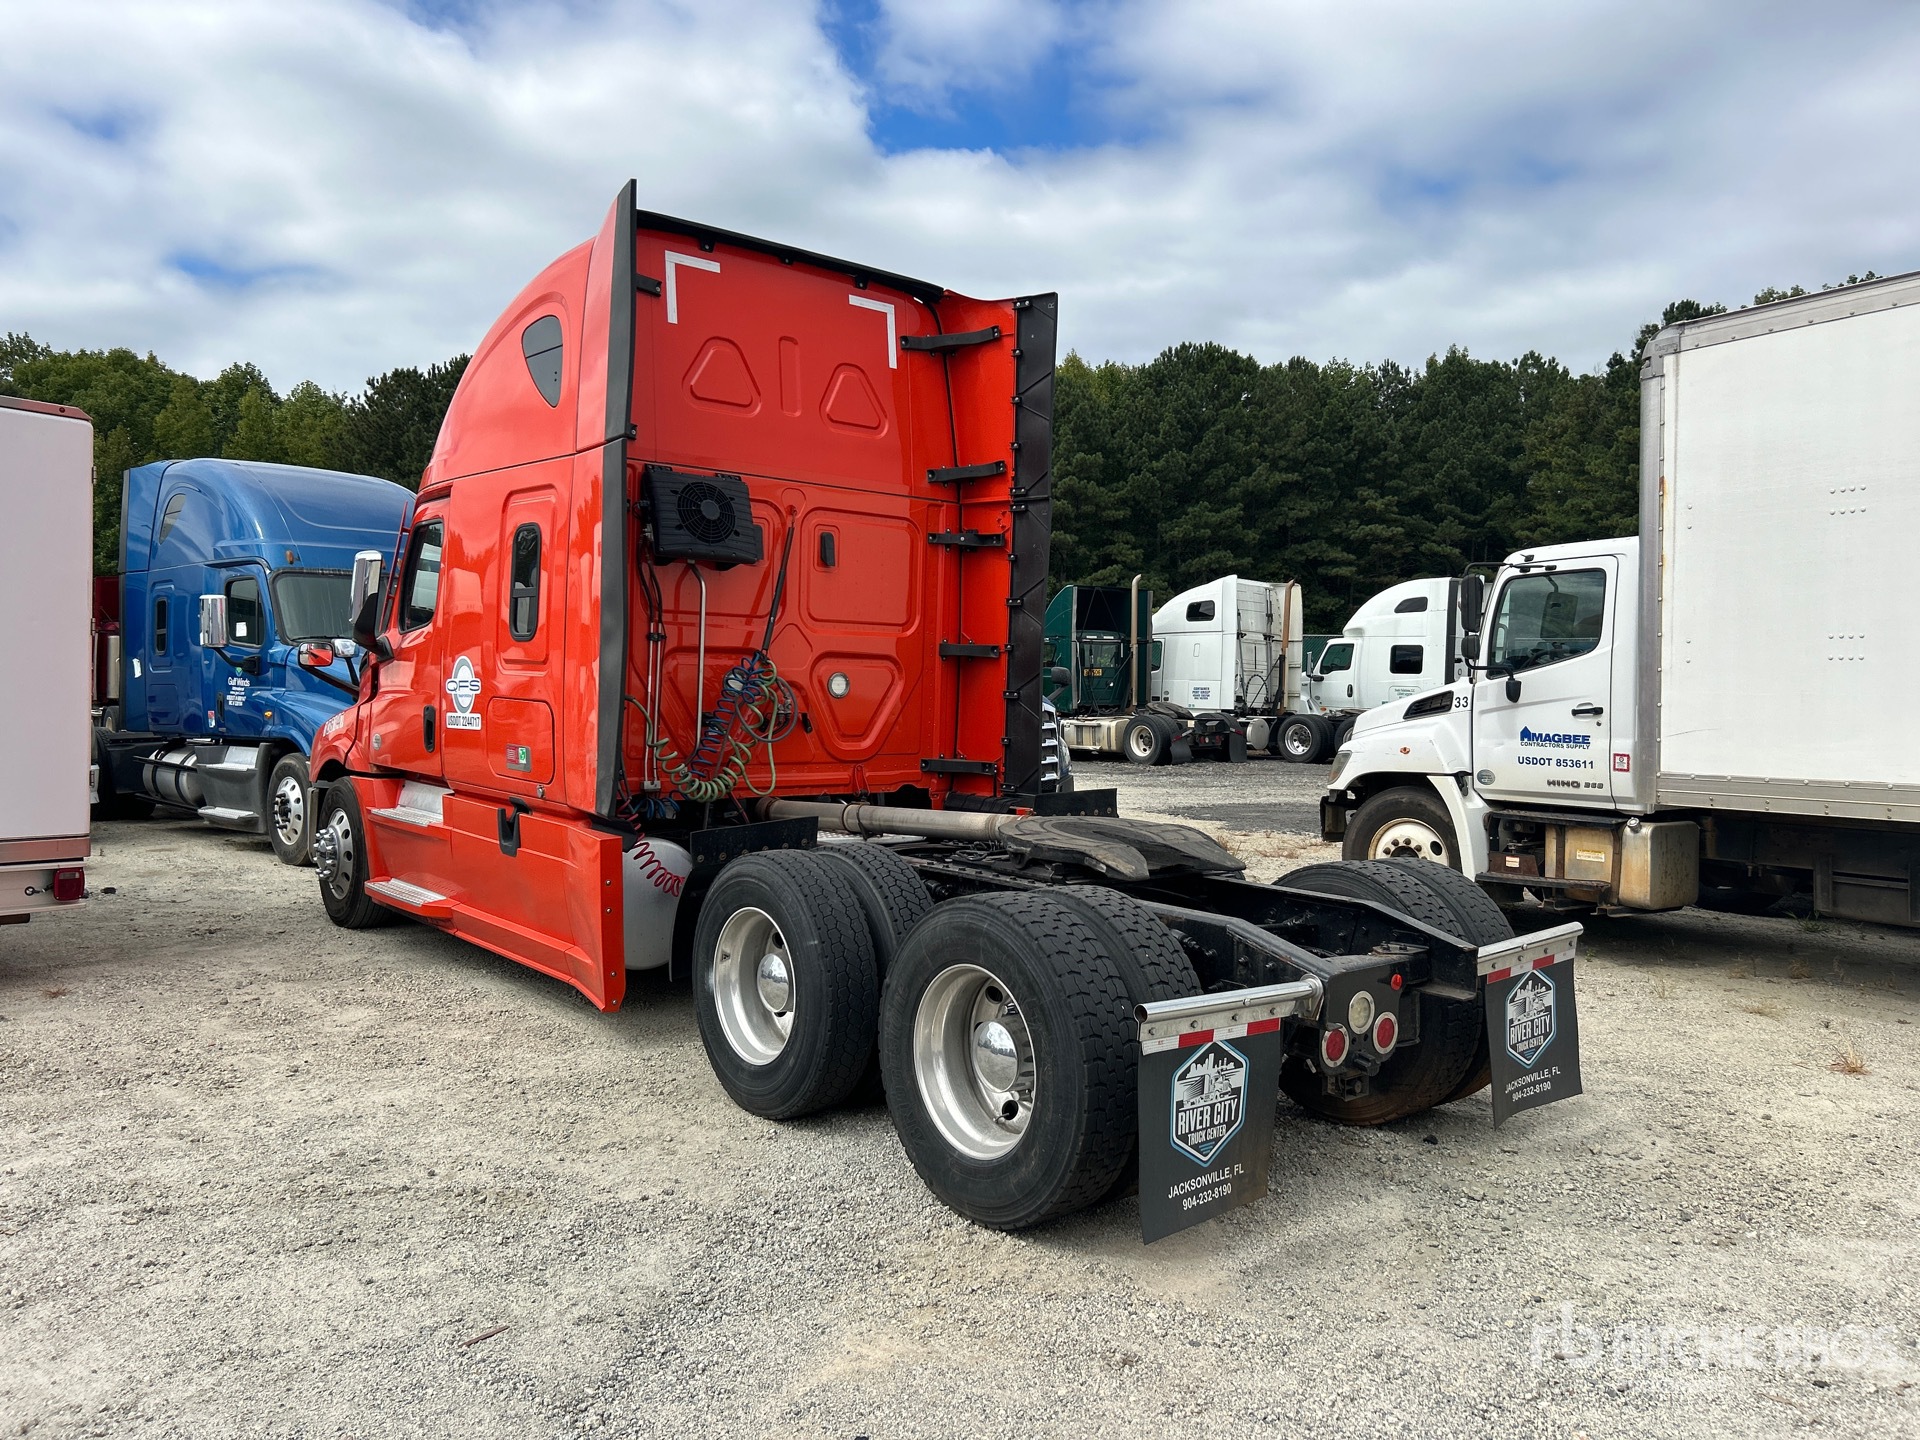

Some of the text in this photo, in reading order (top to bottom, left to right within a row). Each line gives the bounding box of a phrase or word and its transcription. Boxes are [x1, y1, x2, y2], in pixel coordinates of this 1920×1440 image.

[447, 680, 480, 692] QFS
[1454, 696, 1469, 708] 33
[448, 716, 461, 726] USDOT
[1520, 741, 1565, 749] CONTRACTORS
[1531, 732, 1591, 744] MAGBEE
[1517, 756, 1594, 769] USDOT 853611
[1547, 779, 1580, 789] HINO
[1510, 1014, 1550, 1045] RIVER CITY
[1516, 1035, 1544, 1053] TRUCK CENTER
[1505, 1066, 1561, 1094] JACKSONVILLE, FL
[1512, 1081, 1552, 1102] 904-232-8190
[1177, 1099, 1238, 1135] RIVER CITY
[1188, 1124, 1227, 1146] TRUCK CENTER
[1168, 1163, 1244, 1199] JACKSONVILLE, FL
[1182, 1183, 1232, 1211] 904-232-8190
